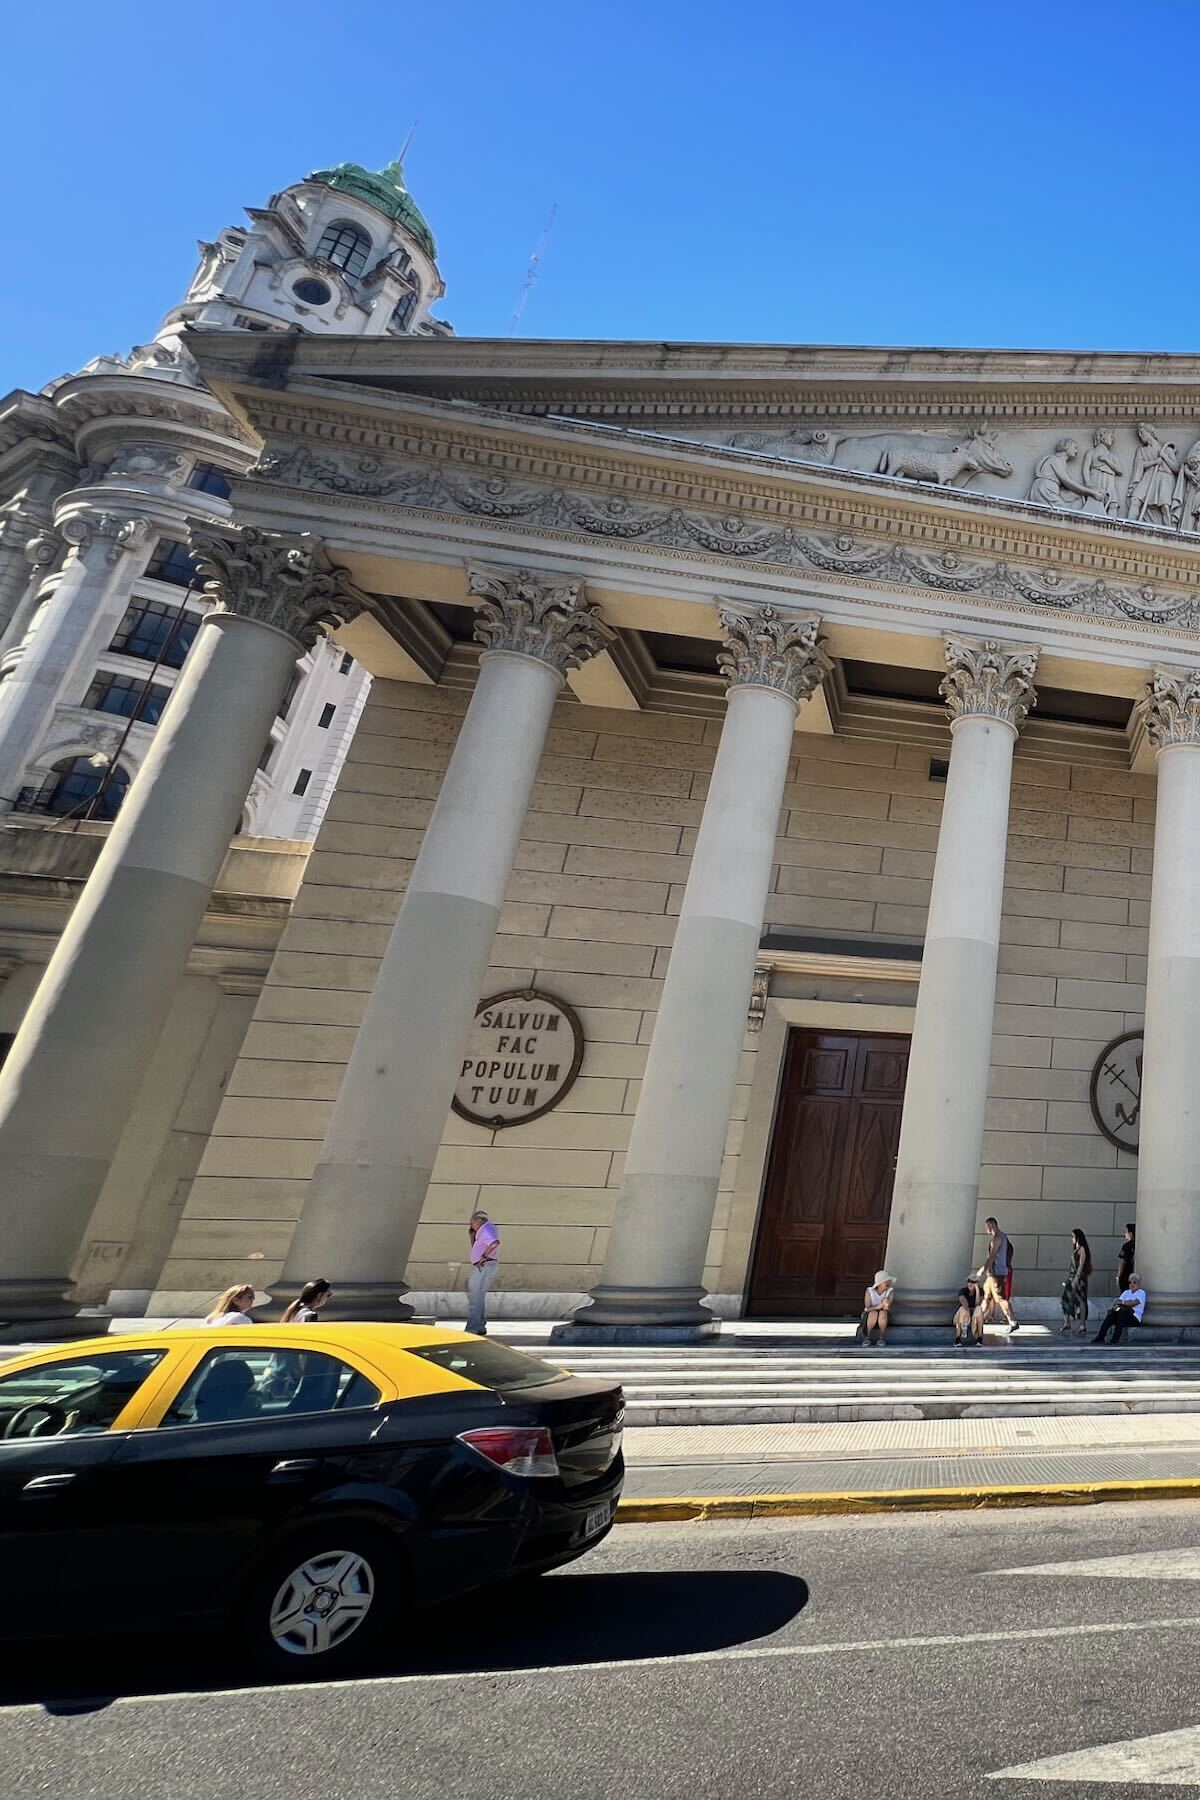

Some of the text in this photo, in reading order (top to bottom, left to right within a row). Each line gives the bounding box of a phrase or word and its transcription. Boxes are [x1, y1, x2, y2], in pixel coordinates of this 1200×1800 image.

[480, 1011, 561, 1032] SALVUM
[496, 1036, 538, 1054] FAC
[460, 1060, 561, 1081] POPULUM
[471, 1086, 539, 1106] TUUM
